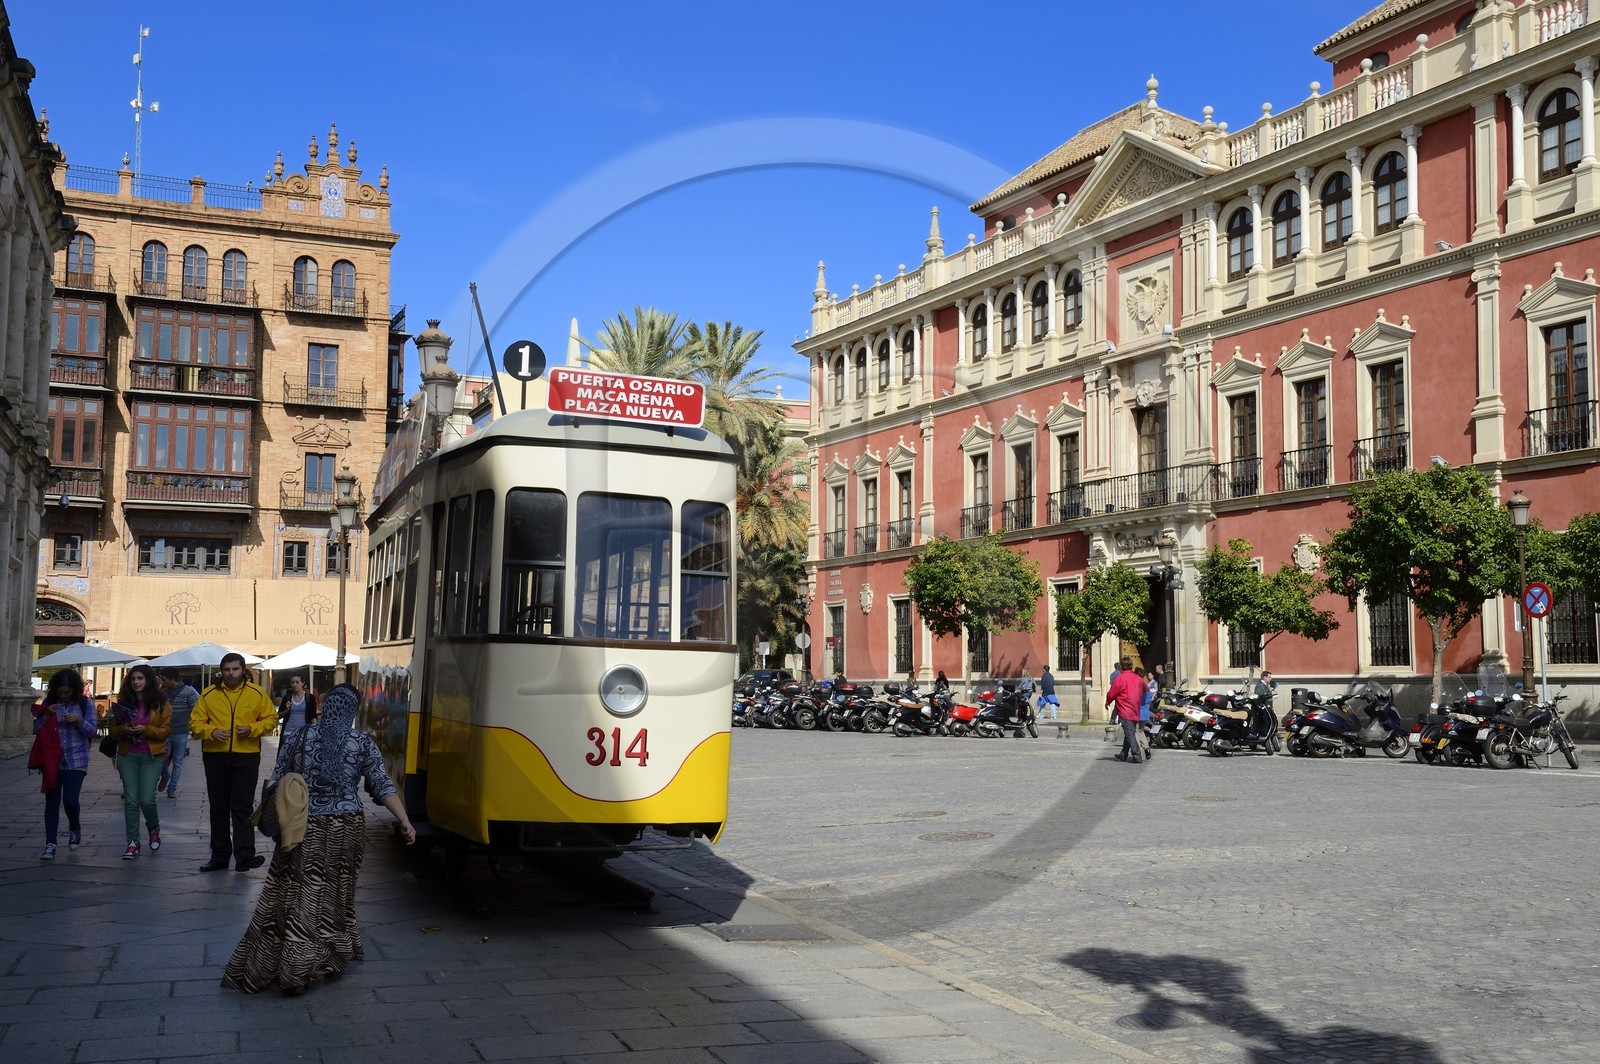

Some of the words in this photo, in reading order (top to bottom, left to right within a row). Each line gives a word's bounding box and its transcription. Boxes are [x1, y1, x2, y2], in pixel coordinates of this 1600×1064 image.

[518, 345, 532, 377] 1
[558, 372, 625, 390] PUERTA
[629, 380, 695, 397] OSARIO
[576, 387, 675, 408] MACARENA
[564, 398, 622, 416] PLAZA
[625, 405, 685, 422] NUEVA
[136, 627, 179, 636] ROBLES
[183, 627, 229, 636] LAREDO
[273, 628, 313, 637] ROBLES
[317, 628, 360, 637] LARDO
[585, 727, 649, 767] 314
